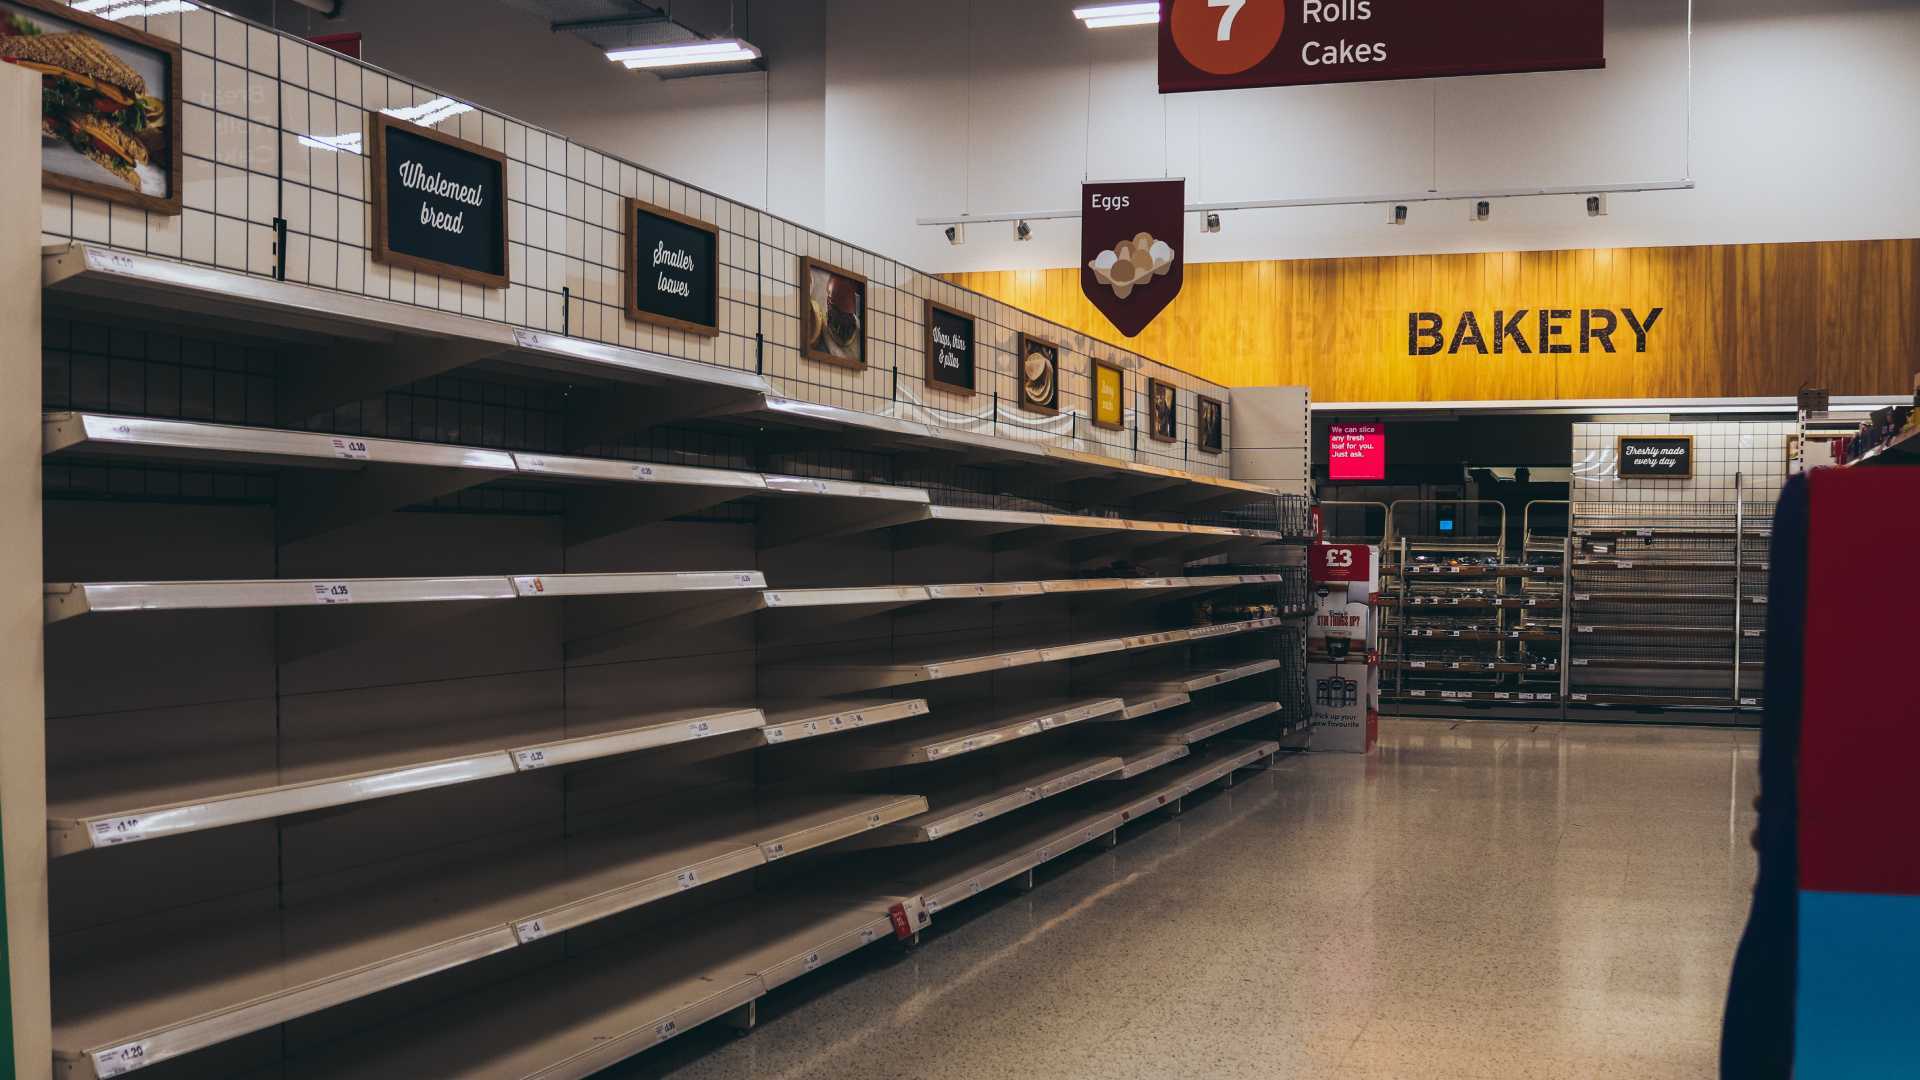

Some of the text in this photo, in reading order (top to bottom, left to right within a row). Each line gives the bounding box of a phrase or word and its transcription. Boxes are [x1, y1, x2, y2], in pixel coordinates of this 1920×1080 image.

[1206, 0, 1246, 41] 7
[1302, 0, 1372, 24] Rolls
[1301, 40, 1388, 66] Cakes
[399, 160, 483, 207] Wholemeal
[1092, 193, 1130, 211] Eggs
[421, 201, 464, 234] bread
[653, 240, 694, 272] Smaller
[657, 271, 690, 297] loaves
[1408, 307, 1664, 356] BAKERY
[1331, 442, 1345, 450] loaf
[1346, 442, 1357, 450] for
[1625, 445, 1685, 457] Freshly made
[1633, 456, 1677, 468] every day
[1326, 548, 1352, 568] £3
